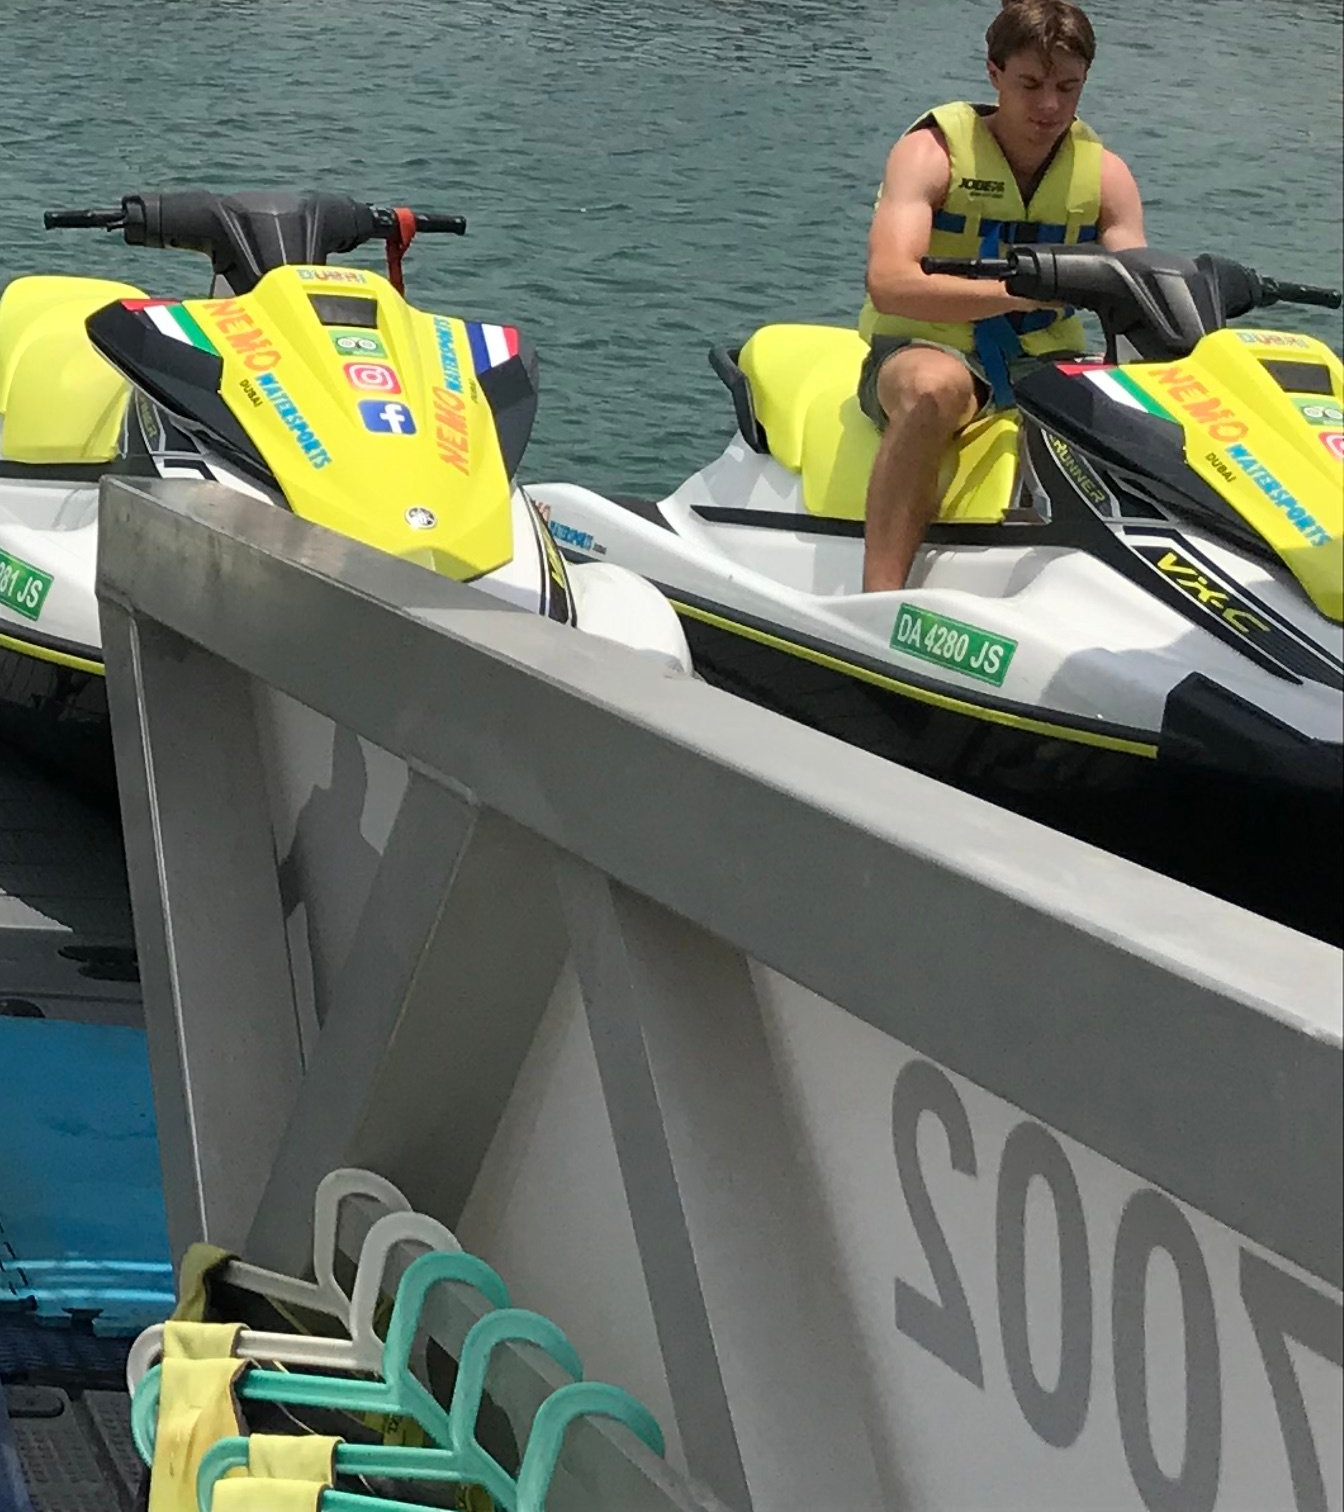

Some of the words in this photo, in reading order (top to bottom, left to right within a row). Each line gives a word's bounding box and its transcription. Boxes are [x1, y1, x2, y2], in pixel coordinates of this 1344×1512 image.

[203, 299, 282, 372] NEMO
[239, 379, 264, 408] DUBAI
[255, 372, 333, 470] WATERSPORTS
[1148, 365, 1249, 443] NEMO
[432, 386, 470, 477] NEMO
[1206, 452, 1237, 483] DUBAI
[1226, 443, 1333, 547] WATERSPORTS
[16, 577, 44, 608] JS
[1156, 552, 1271, 634] VX-C
[897, 613, 923, 648] DA
[923, 623, 970, 663] 4280
[969, 641, 1004, 674] JS
